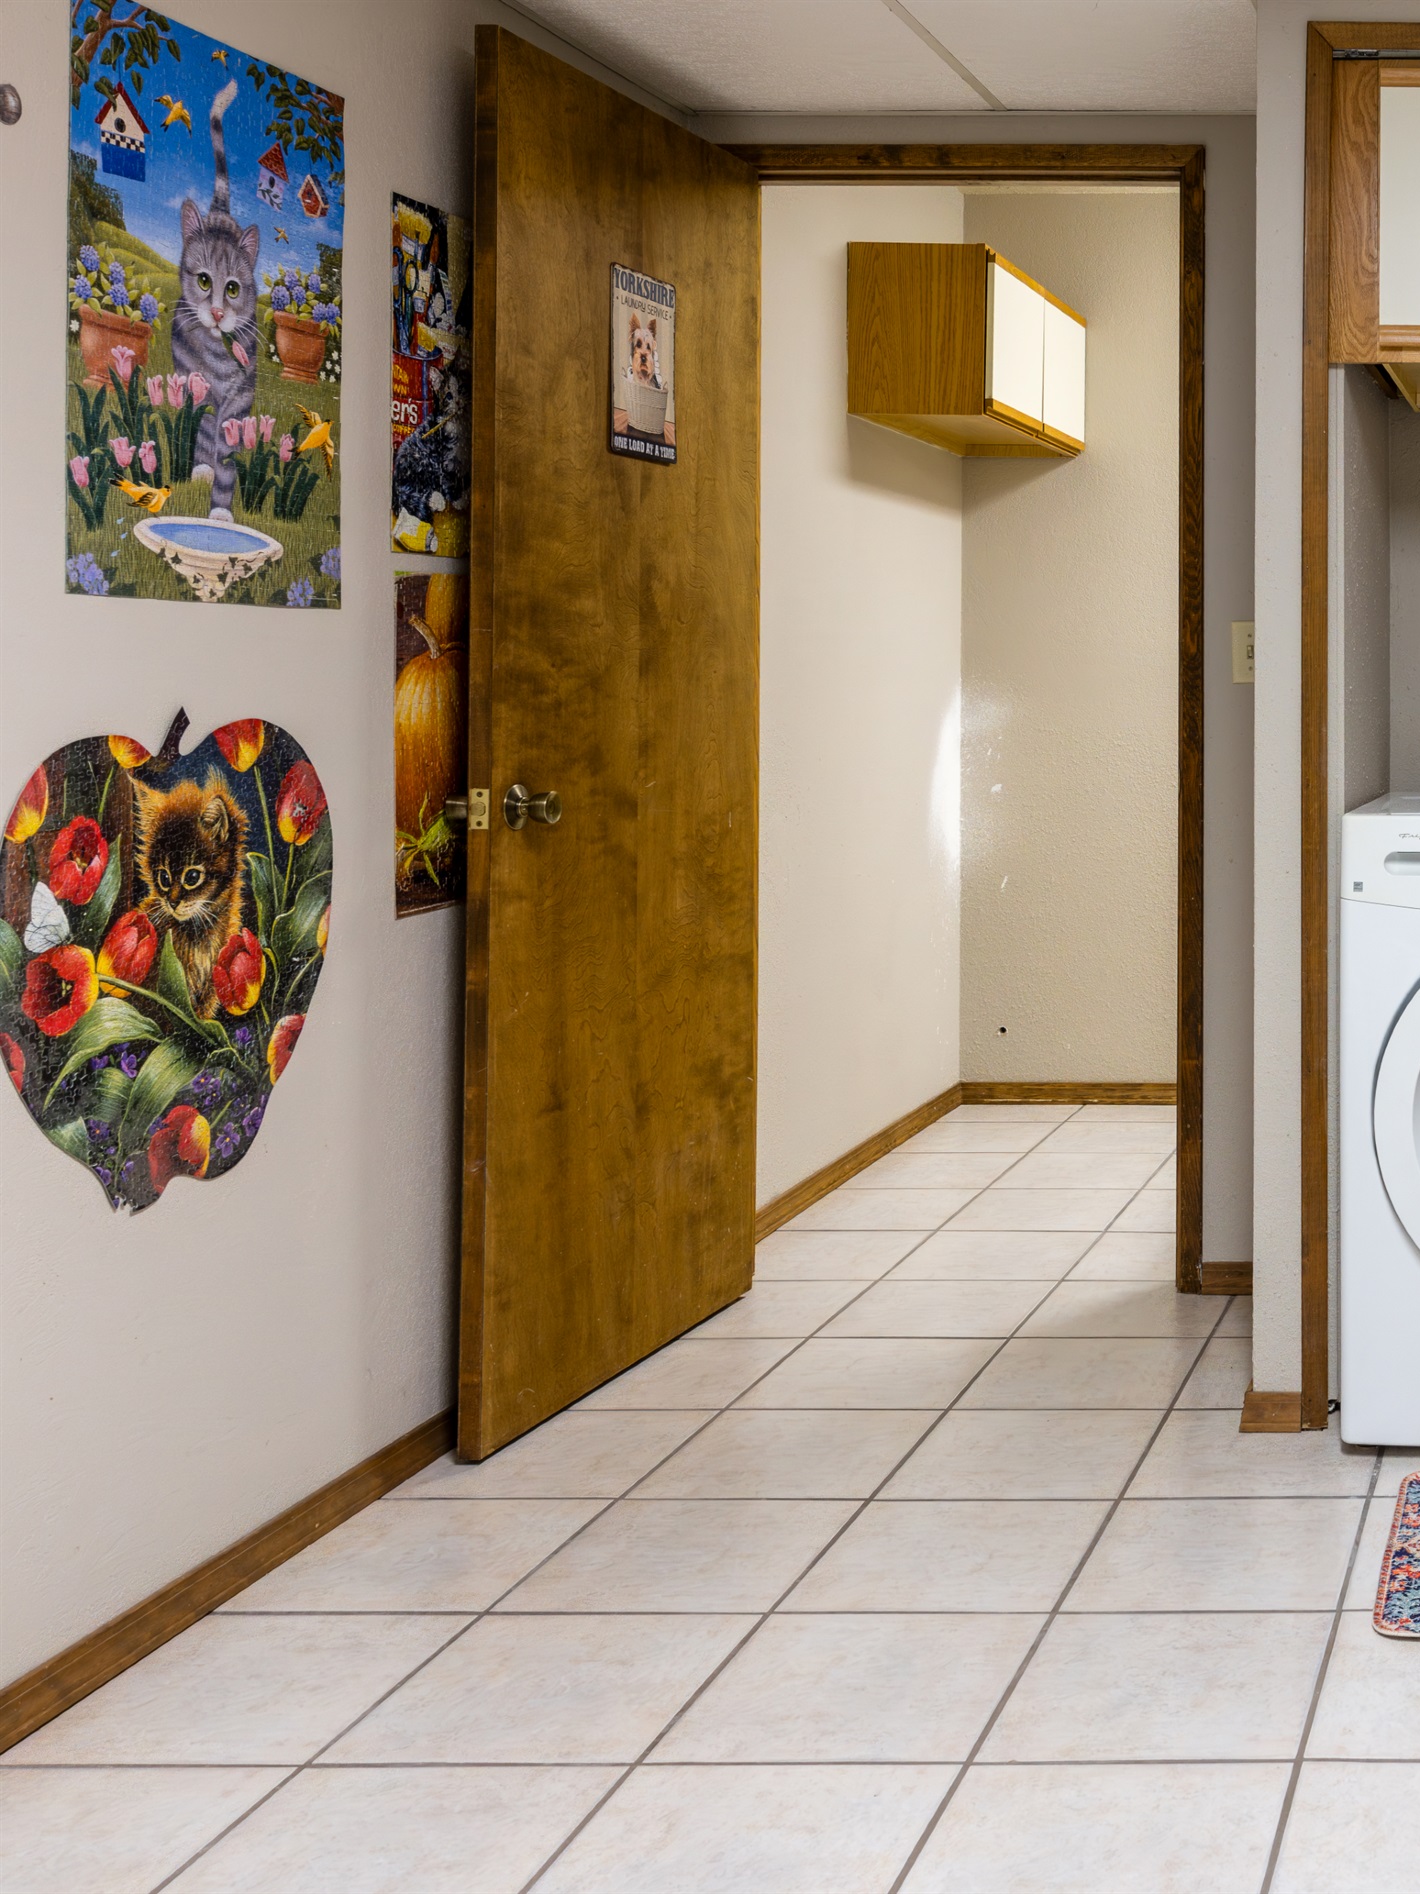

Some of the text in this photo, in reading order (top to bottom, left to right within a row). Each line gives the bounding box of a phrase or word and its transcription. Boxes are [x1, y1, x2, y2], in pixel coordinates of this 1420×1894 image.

[614, 268, 674, 308] YORKSHIRE
[621, 294, 669, 321] LAUNDRY SERVICE
[614, 435, 675, 460] ONE LOAD AT A TIME
